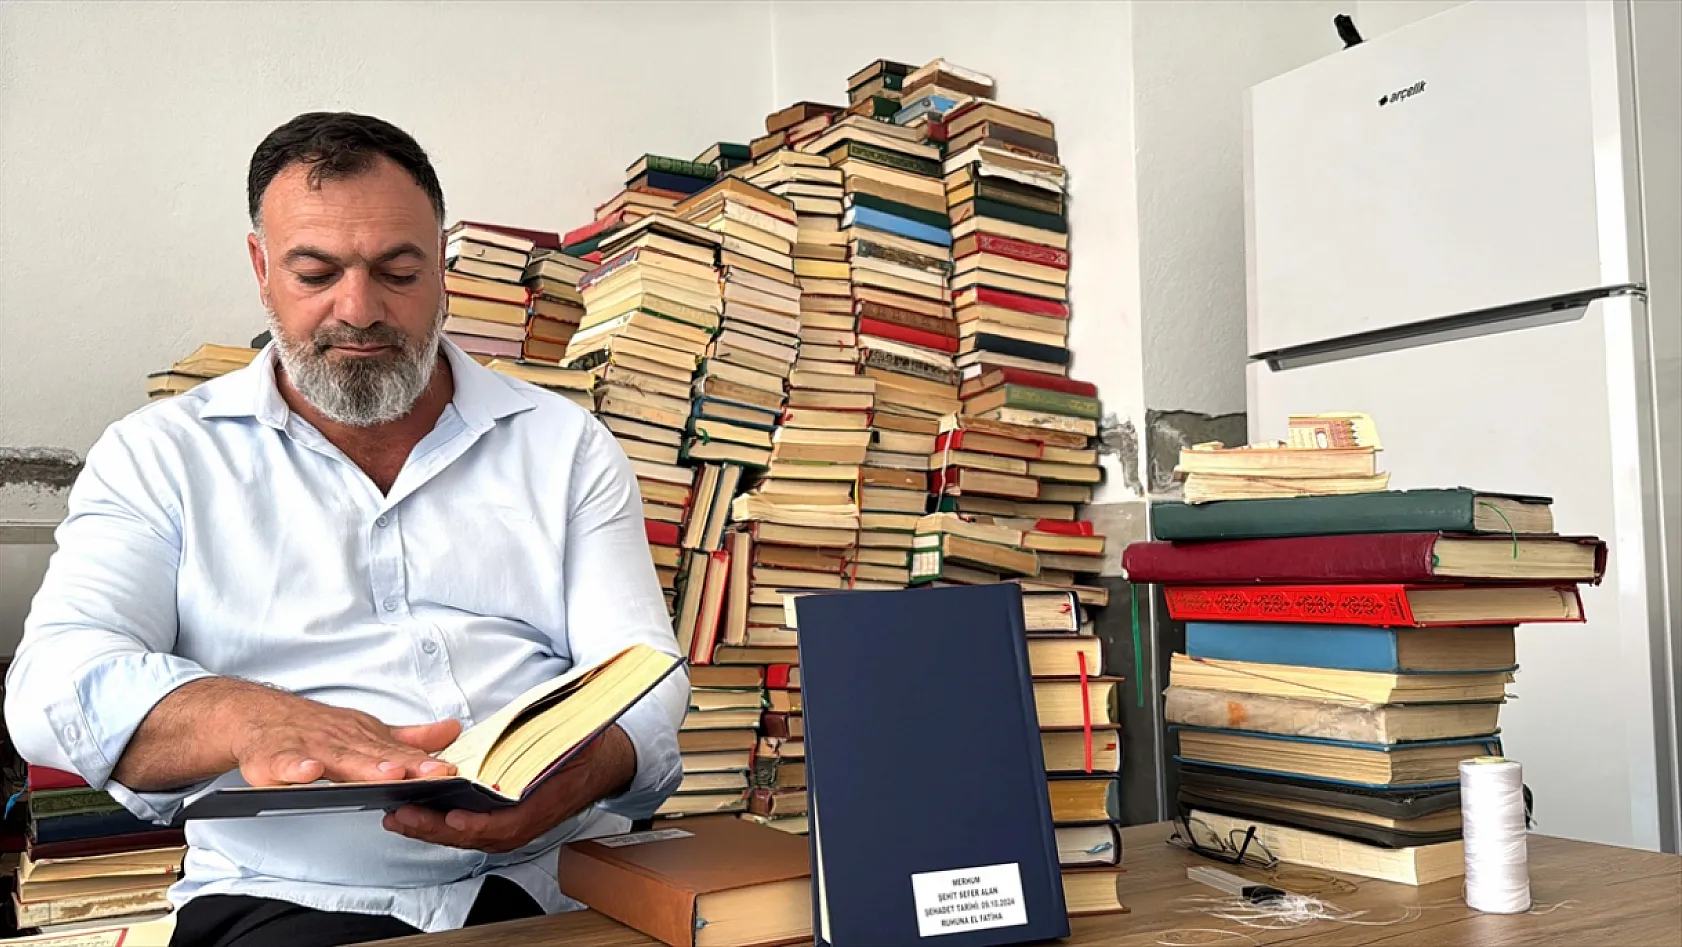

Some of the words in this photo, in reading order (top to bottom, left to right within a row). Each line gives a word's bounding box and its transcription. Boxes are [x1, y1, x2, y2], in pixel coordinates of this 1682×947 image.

[1389, 80, 1427, 103] arçelik
[952, 876, 981, 886] MERHUM
[959, 888, 979, 899] SEFER
[981, 886, 998, 896] ALAN
[941, 916, 969, 927] RUHUNA
[970, 915, 979, 924] EL
